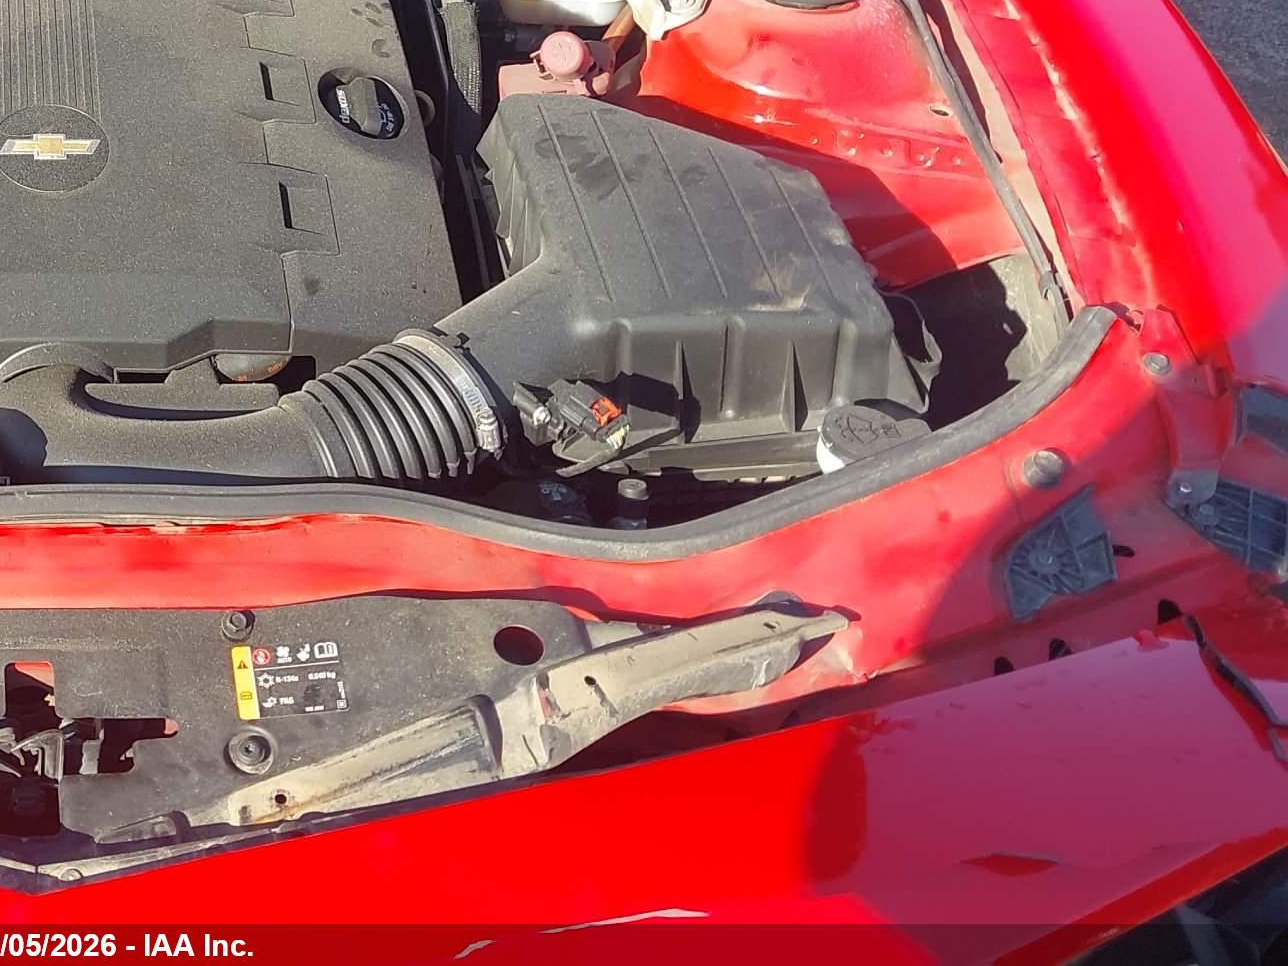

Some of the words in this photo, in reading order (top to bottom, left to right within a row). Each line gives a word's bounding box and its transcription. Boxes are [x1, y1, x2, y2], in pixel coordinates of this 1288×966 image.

[336, 88, 351, 124] dexos
[275, 675, 299, 683] R-134a
[279, 697, 294, 705] PAG
